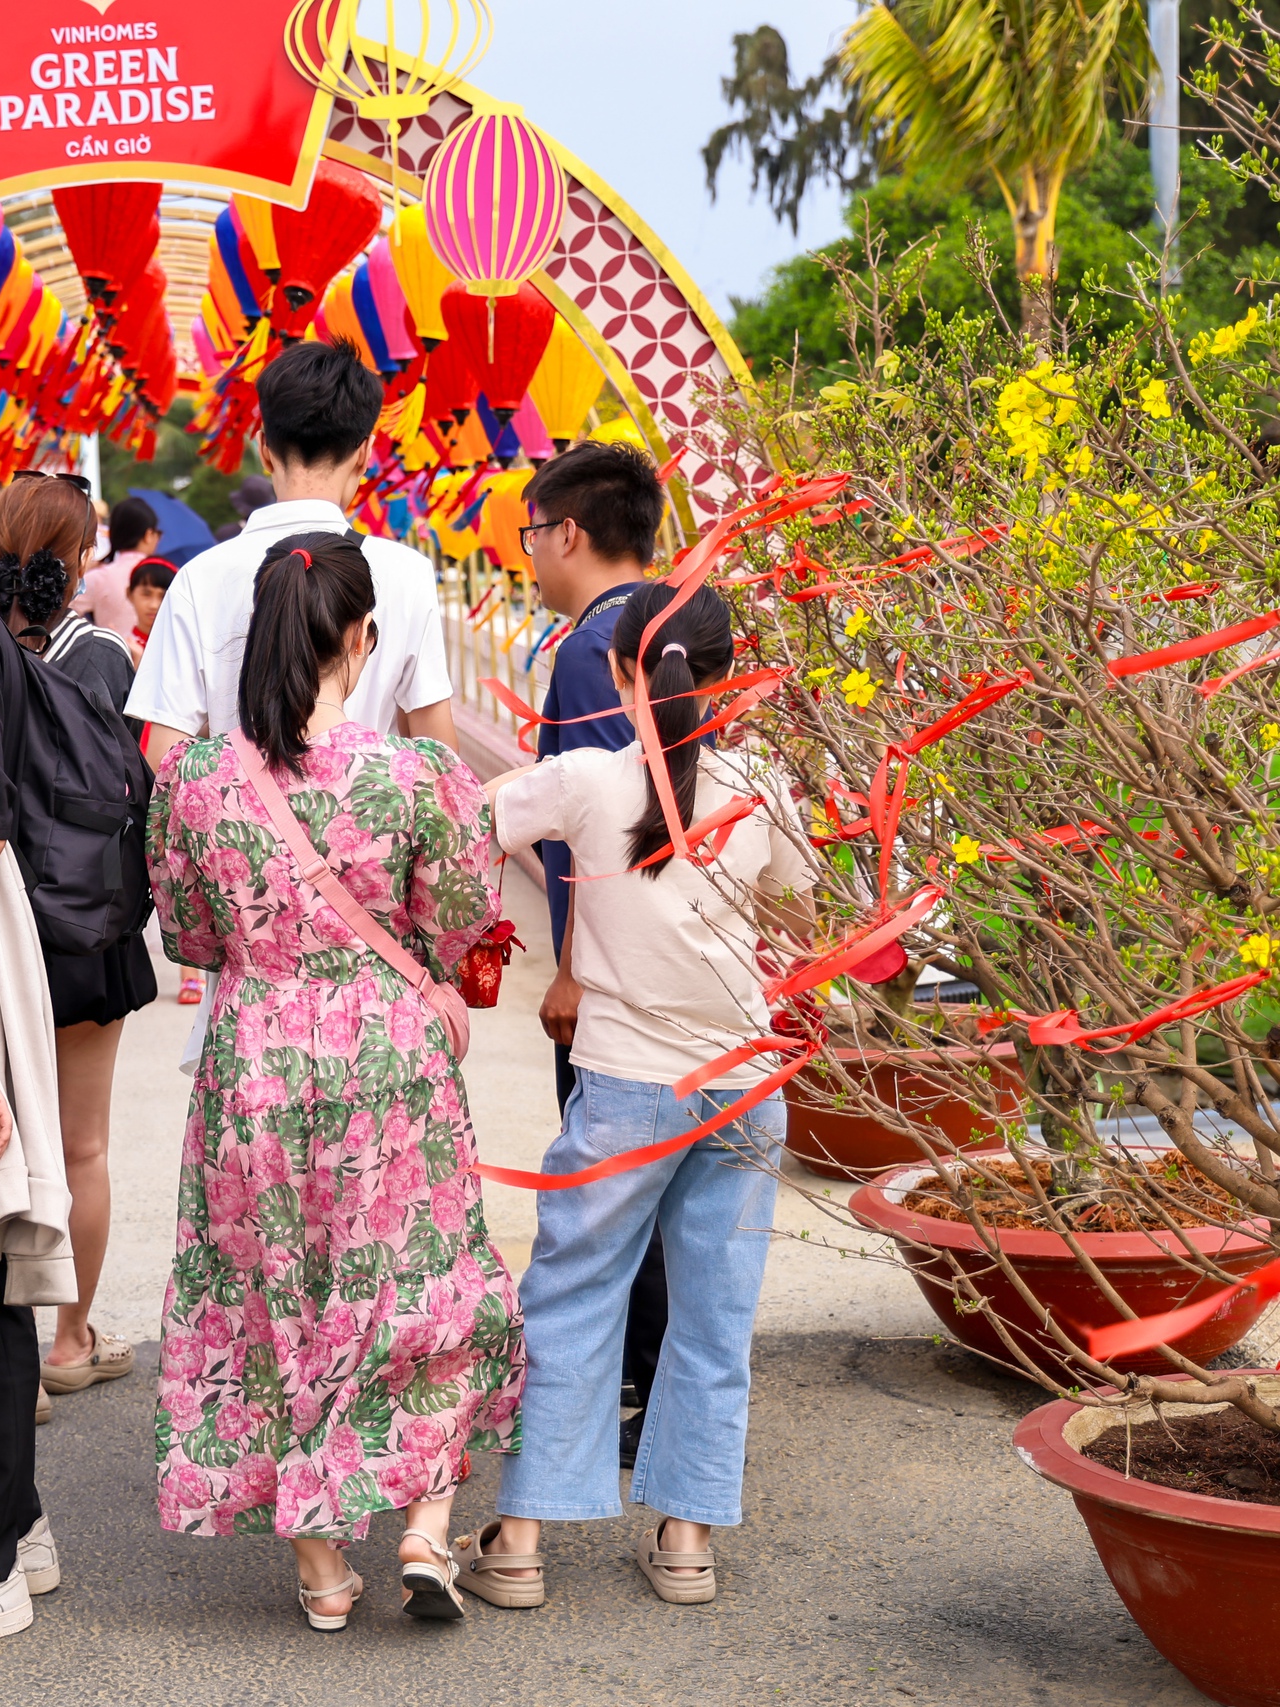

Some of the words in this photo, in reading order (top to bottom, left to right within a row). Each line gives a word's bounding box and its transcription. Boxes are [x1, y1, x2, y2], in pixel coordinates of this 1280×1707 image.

[51, 22, 158, 45] VINHOMES
[31, 46, 179, 90] GREEN
[114, 133, 152, 155] GIỜ
